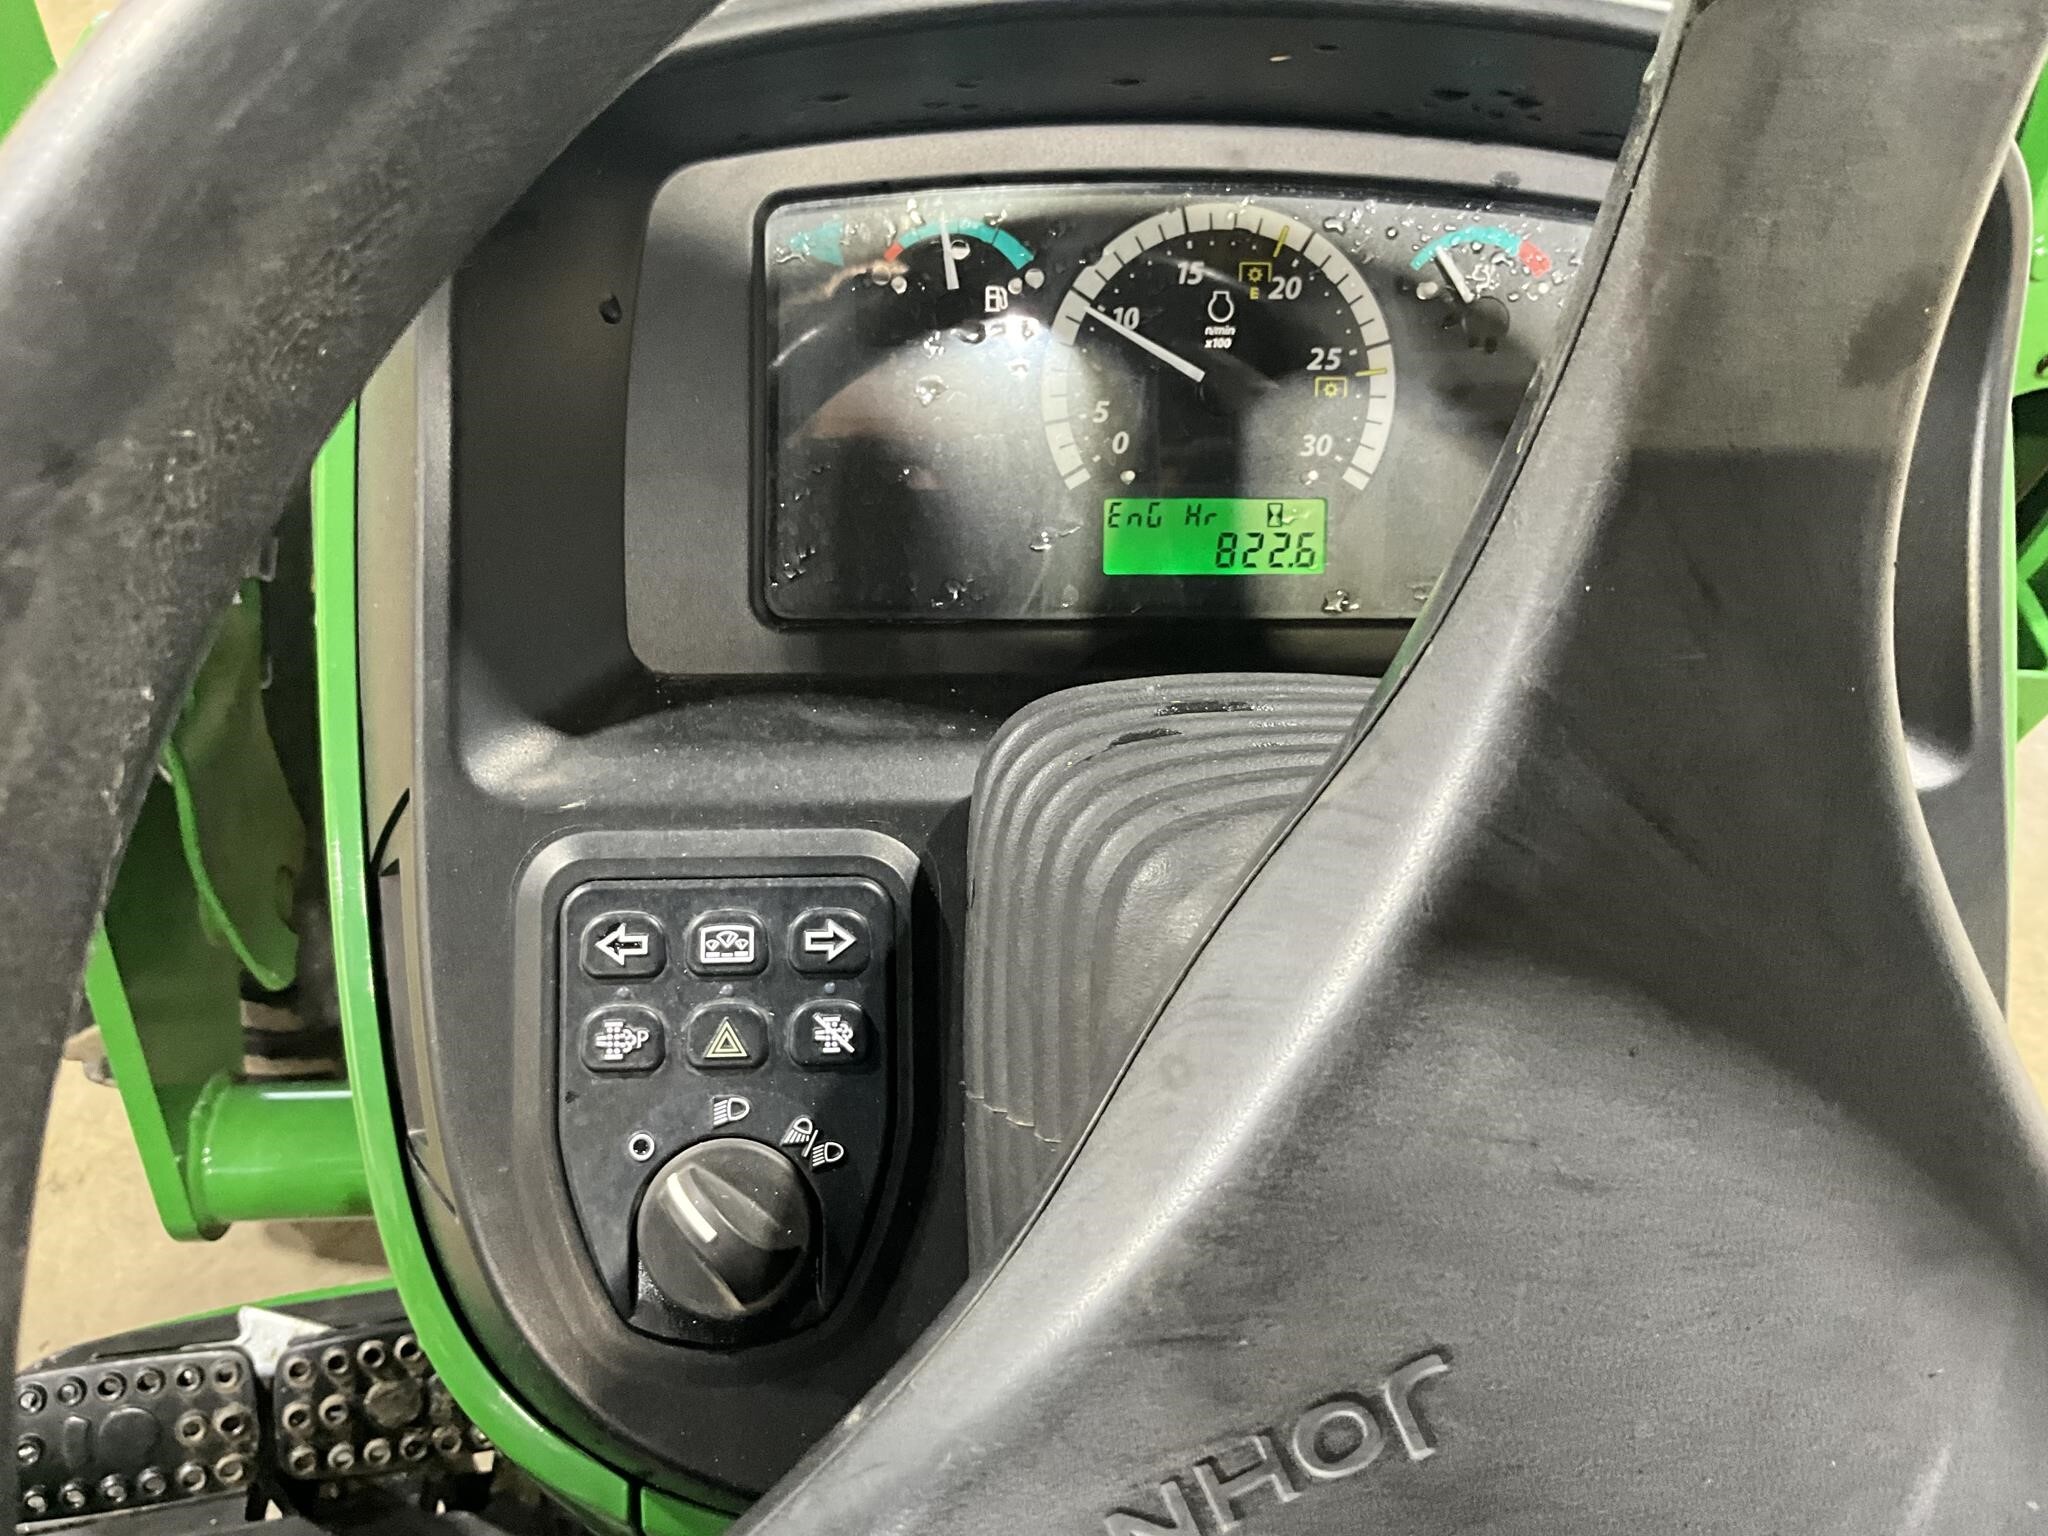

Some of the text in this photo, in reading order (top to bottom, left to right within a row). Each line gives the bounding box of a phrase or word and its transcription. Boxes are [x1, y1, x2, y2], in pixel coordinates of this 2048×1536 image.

[1178, 261, 1204, 285] 15
[1249, 287, 1259, 300] E
[1268, 276, 1302, 300] 20
[1113, 306, 1140, 330] 10
[1204, 337, 1232, 349] x100
[1307, 348, 1342, 371] 25
[1092, 400, 1110, 423] 5
[1111, 431, 1129, 455] 0
[1300, 434, 1333, 457] 30
[1185, 503, 1217, 527] Hr
[1215, 532, 1316, 569] 822.6
